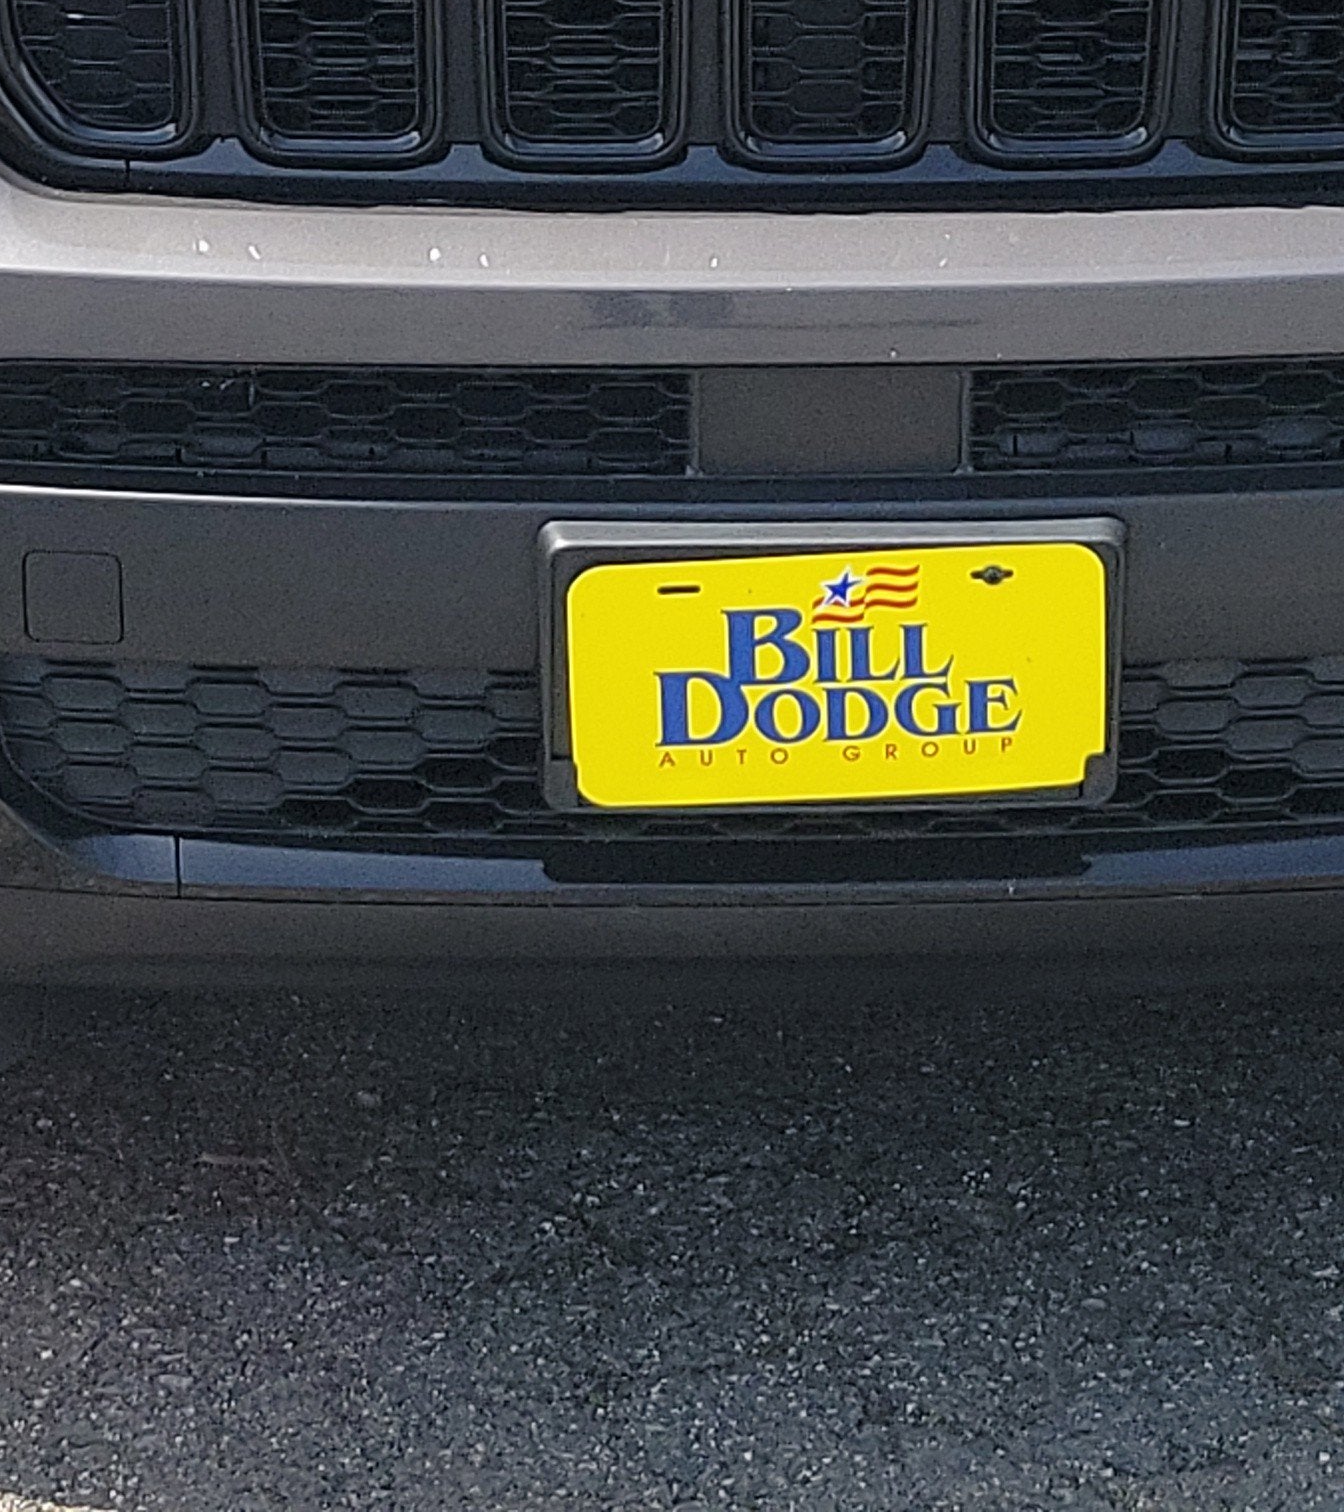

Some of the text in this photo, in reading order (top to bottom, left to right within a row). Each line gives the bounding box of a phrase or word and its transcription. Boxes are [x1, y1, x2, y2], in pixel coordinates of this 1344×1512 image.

[721, 607, 955, 687] BILL
[653, 669, 1023, 748] DODGE
[658, 736, 1015, 769] AUTO GROUP
